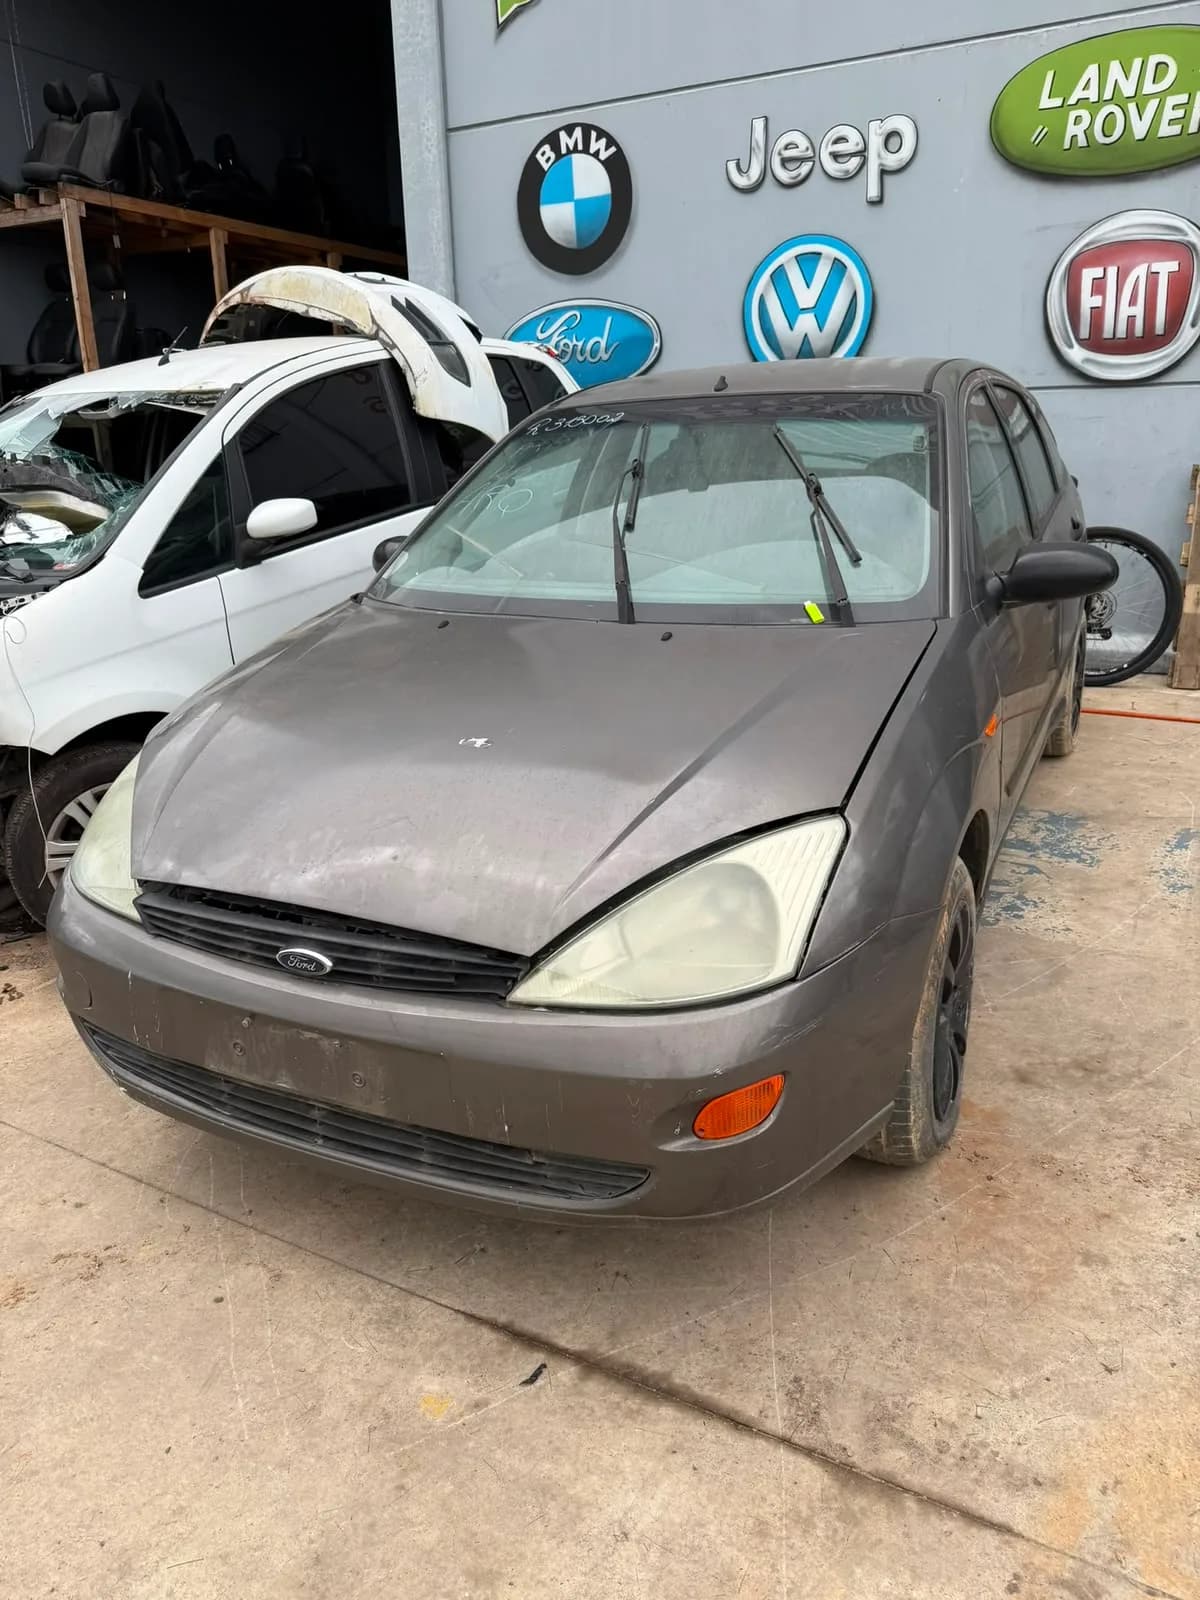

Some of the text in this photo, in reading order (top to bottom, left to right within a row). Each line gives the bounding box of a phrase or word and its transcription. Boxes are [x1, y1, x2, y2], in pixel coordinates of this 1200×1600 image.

[1039, 54, 1178, 110] LAND
[535, 126, 617, 172] BMW
[725, 115, 918, 205] Jeep
[1080, 260, 1181, 340] FIAT
[535, 310, 620, 364] Ford
[287, 954, 316, 972] Ford
